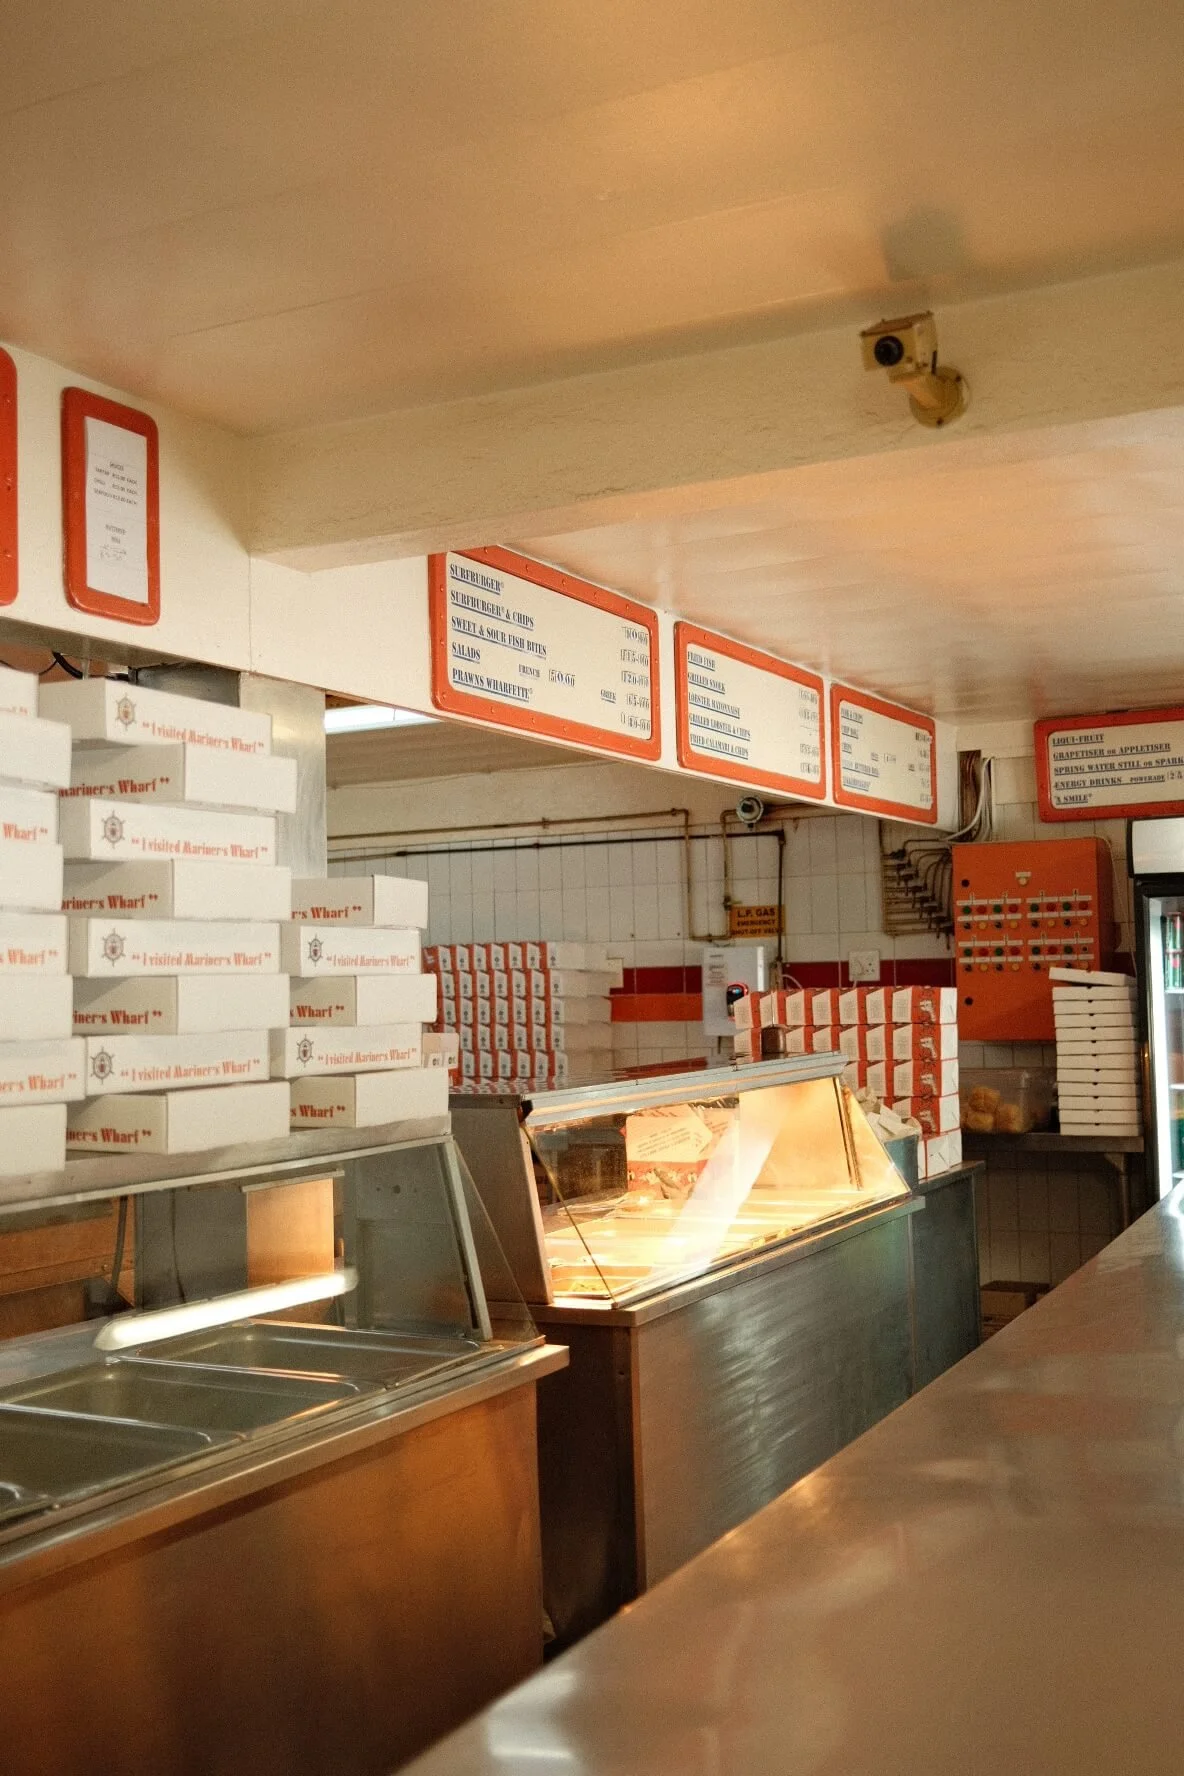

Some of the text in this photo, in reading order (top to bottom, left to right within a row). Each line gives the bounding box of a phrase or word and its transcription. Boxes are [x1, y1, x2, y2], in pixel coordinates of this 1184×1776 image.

[450, 563, 500, 593] SURFBURGER
[451, 590, 534, 628] SURFBURGER & CHIPS
[452, 616, 547, 656] SWEET & SOUR FISH BITES
[452, 642, 480, 660] SALADS
[452, 668, 530, 699] PRAWNS WHARFETTE
[158, 727, 186, 739] visited
[1052, 733, 1104, 746] LIQUI-FRUIT
[1053, 749, 1105, 760] GRAPETISER
[1119, 743, 1171, 755] APPLETISER
[1054, 765, 1085, 775] SPRING
[1088, 762, 1115, 772] WATER
[1118, 760, 1141, 769] STILL
[1055, 781, 1087, 790] ENERGY
[1090, 777, 1122, 787] DRINKS
[1130, 775, 1165, 783] POWERADE
[148, 840, 180, 853] visited
[756, 907, 776, 917] GAS
[149, 953, 182, 966] visited
[338, 955, 358, 966] visited
[330, 1052, 354, 1064] visited
[138, 1066, 172, 1080] visited
